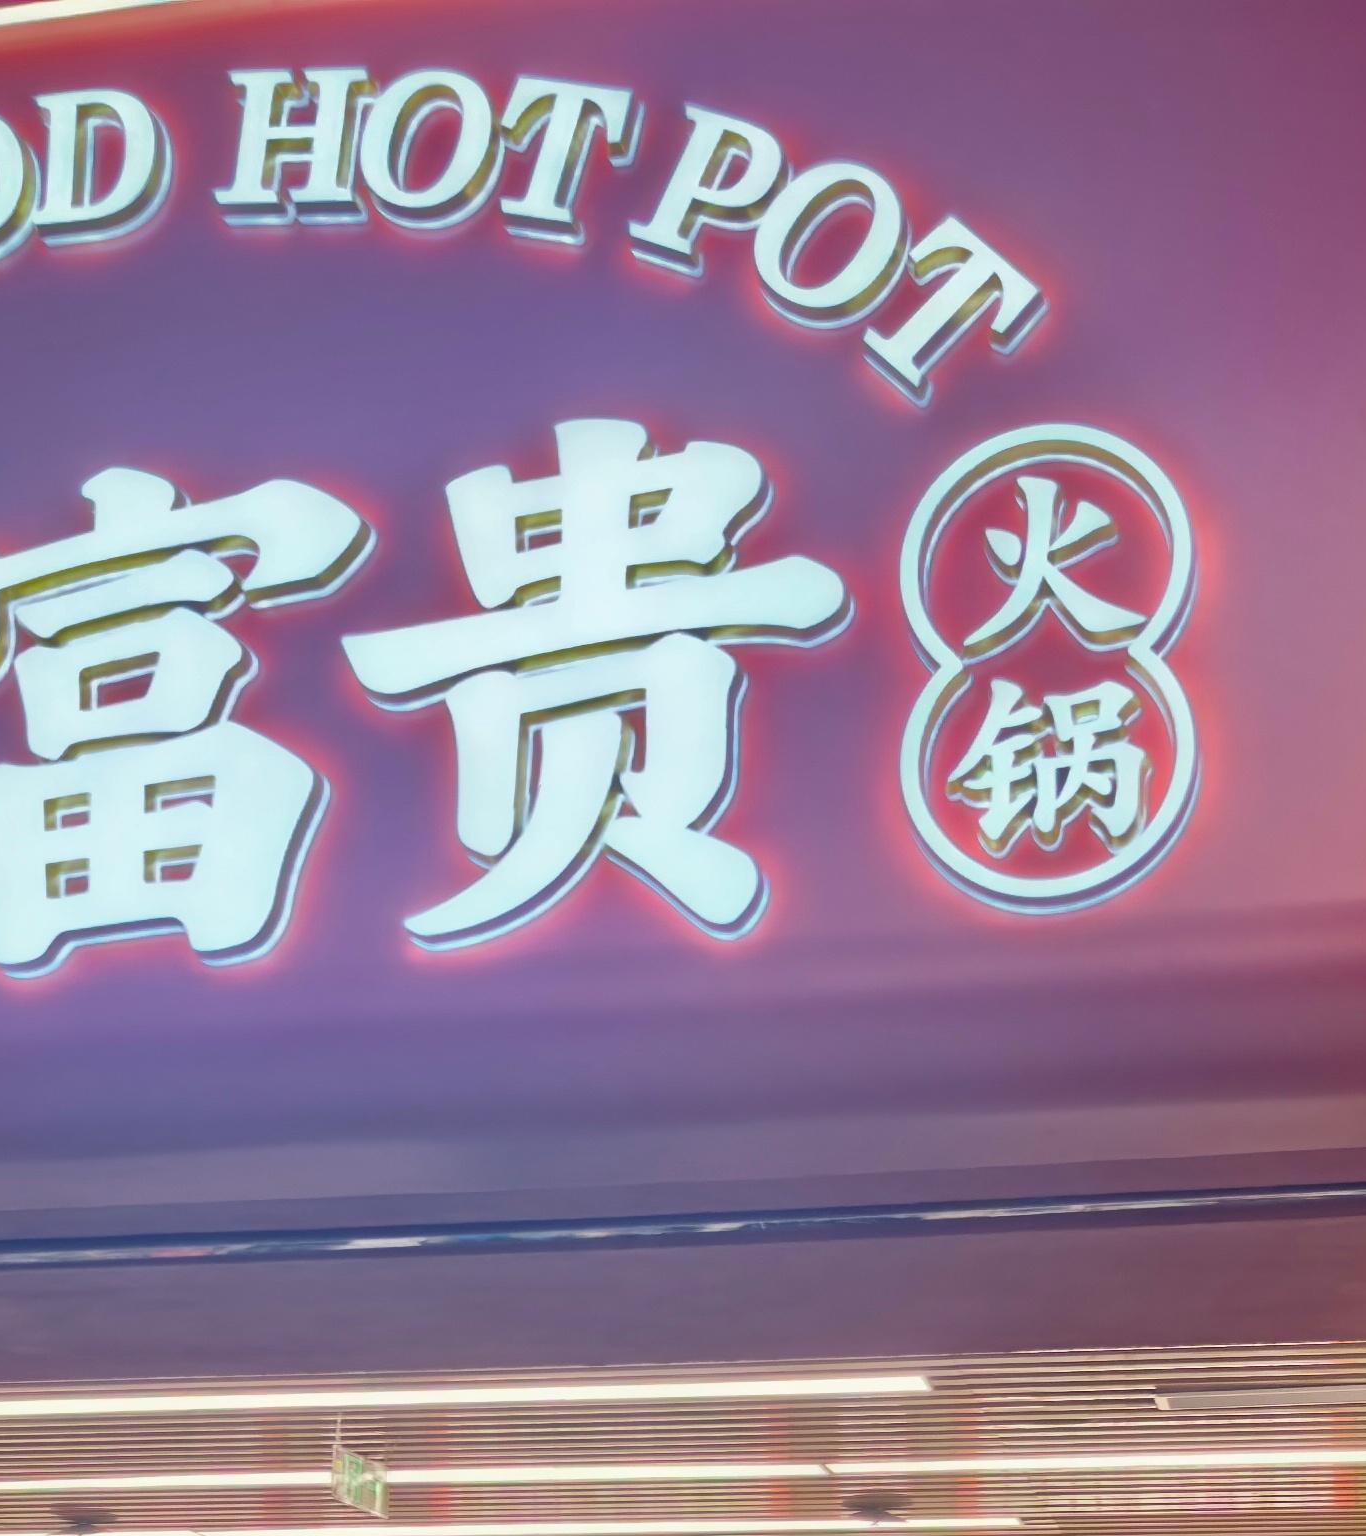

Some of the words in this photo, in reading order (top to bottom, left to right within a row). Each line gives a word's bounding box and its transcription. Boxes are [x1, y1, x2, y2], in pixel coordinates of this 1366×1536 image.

[214, 66, 643, 244] HOT
[629, 102, 1047, 407] POT
[947, 474, 1151, 860] 火锅
